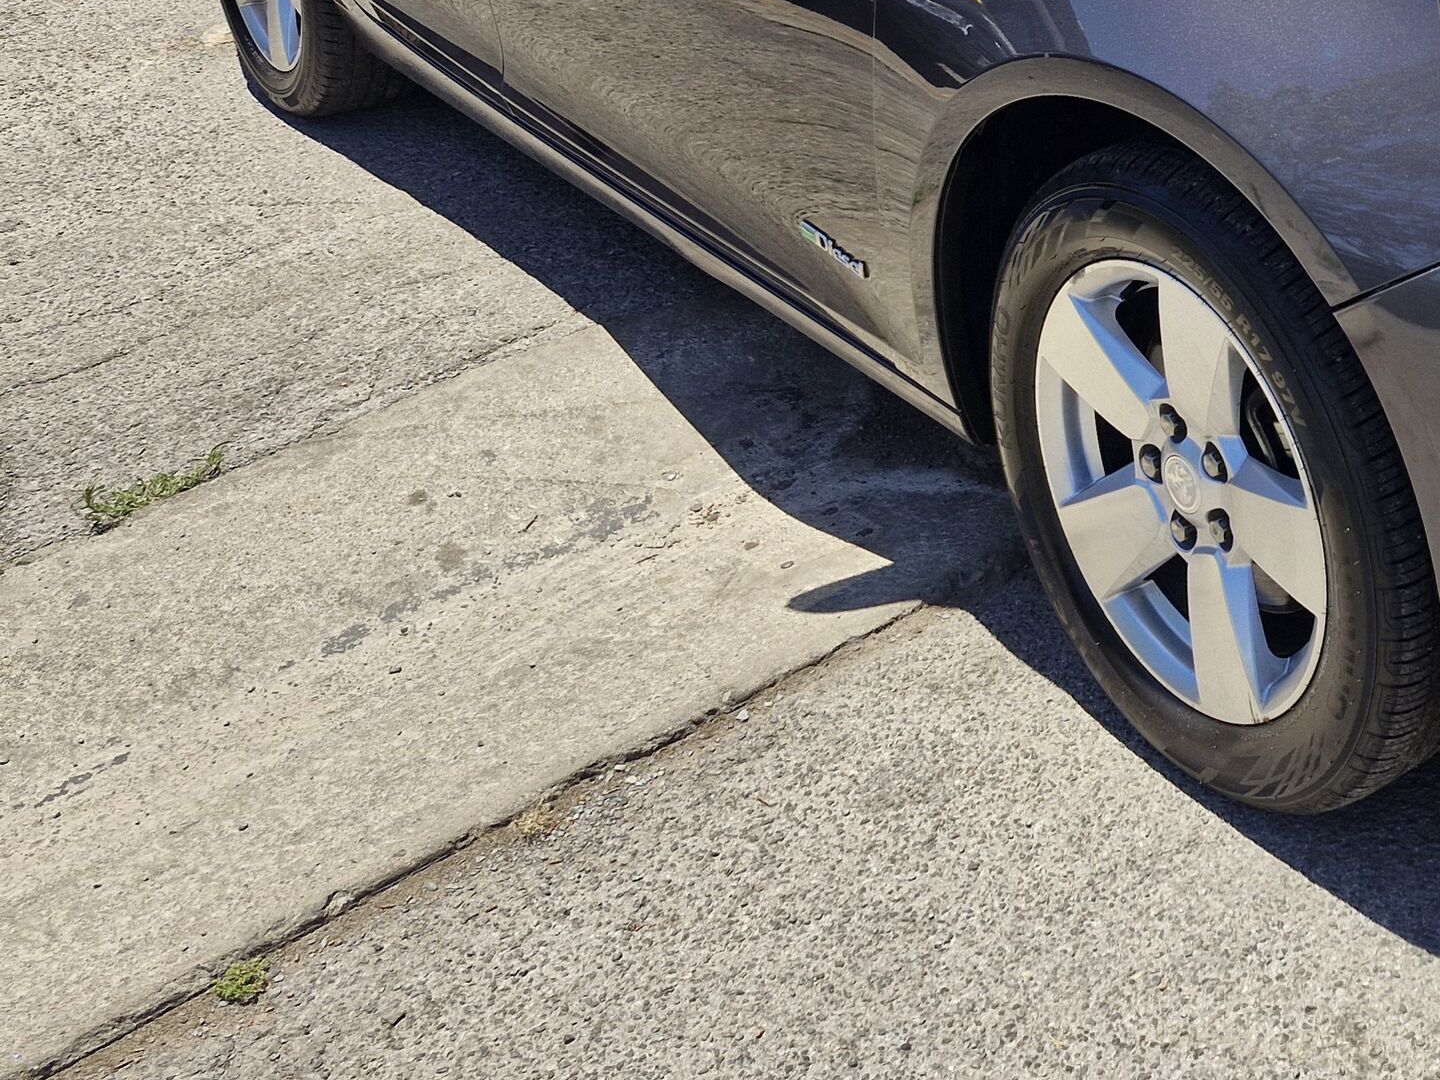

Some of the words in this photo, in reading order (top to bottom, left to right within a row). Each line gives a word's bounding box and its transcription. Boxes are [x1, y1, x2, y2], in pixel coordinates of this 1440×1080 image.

[815, 230, 867, 280] Diesel
[1172, 245, 1235, 312] 225/55
[1236, 312, 1274, 363] R17
[1270, 370, 1308, 427] 97V
